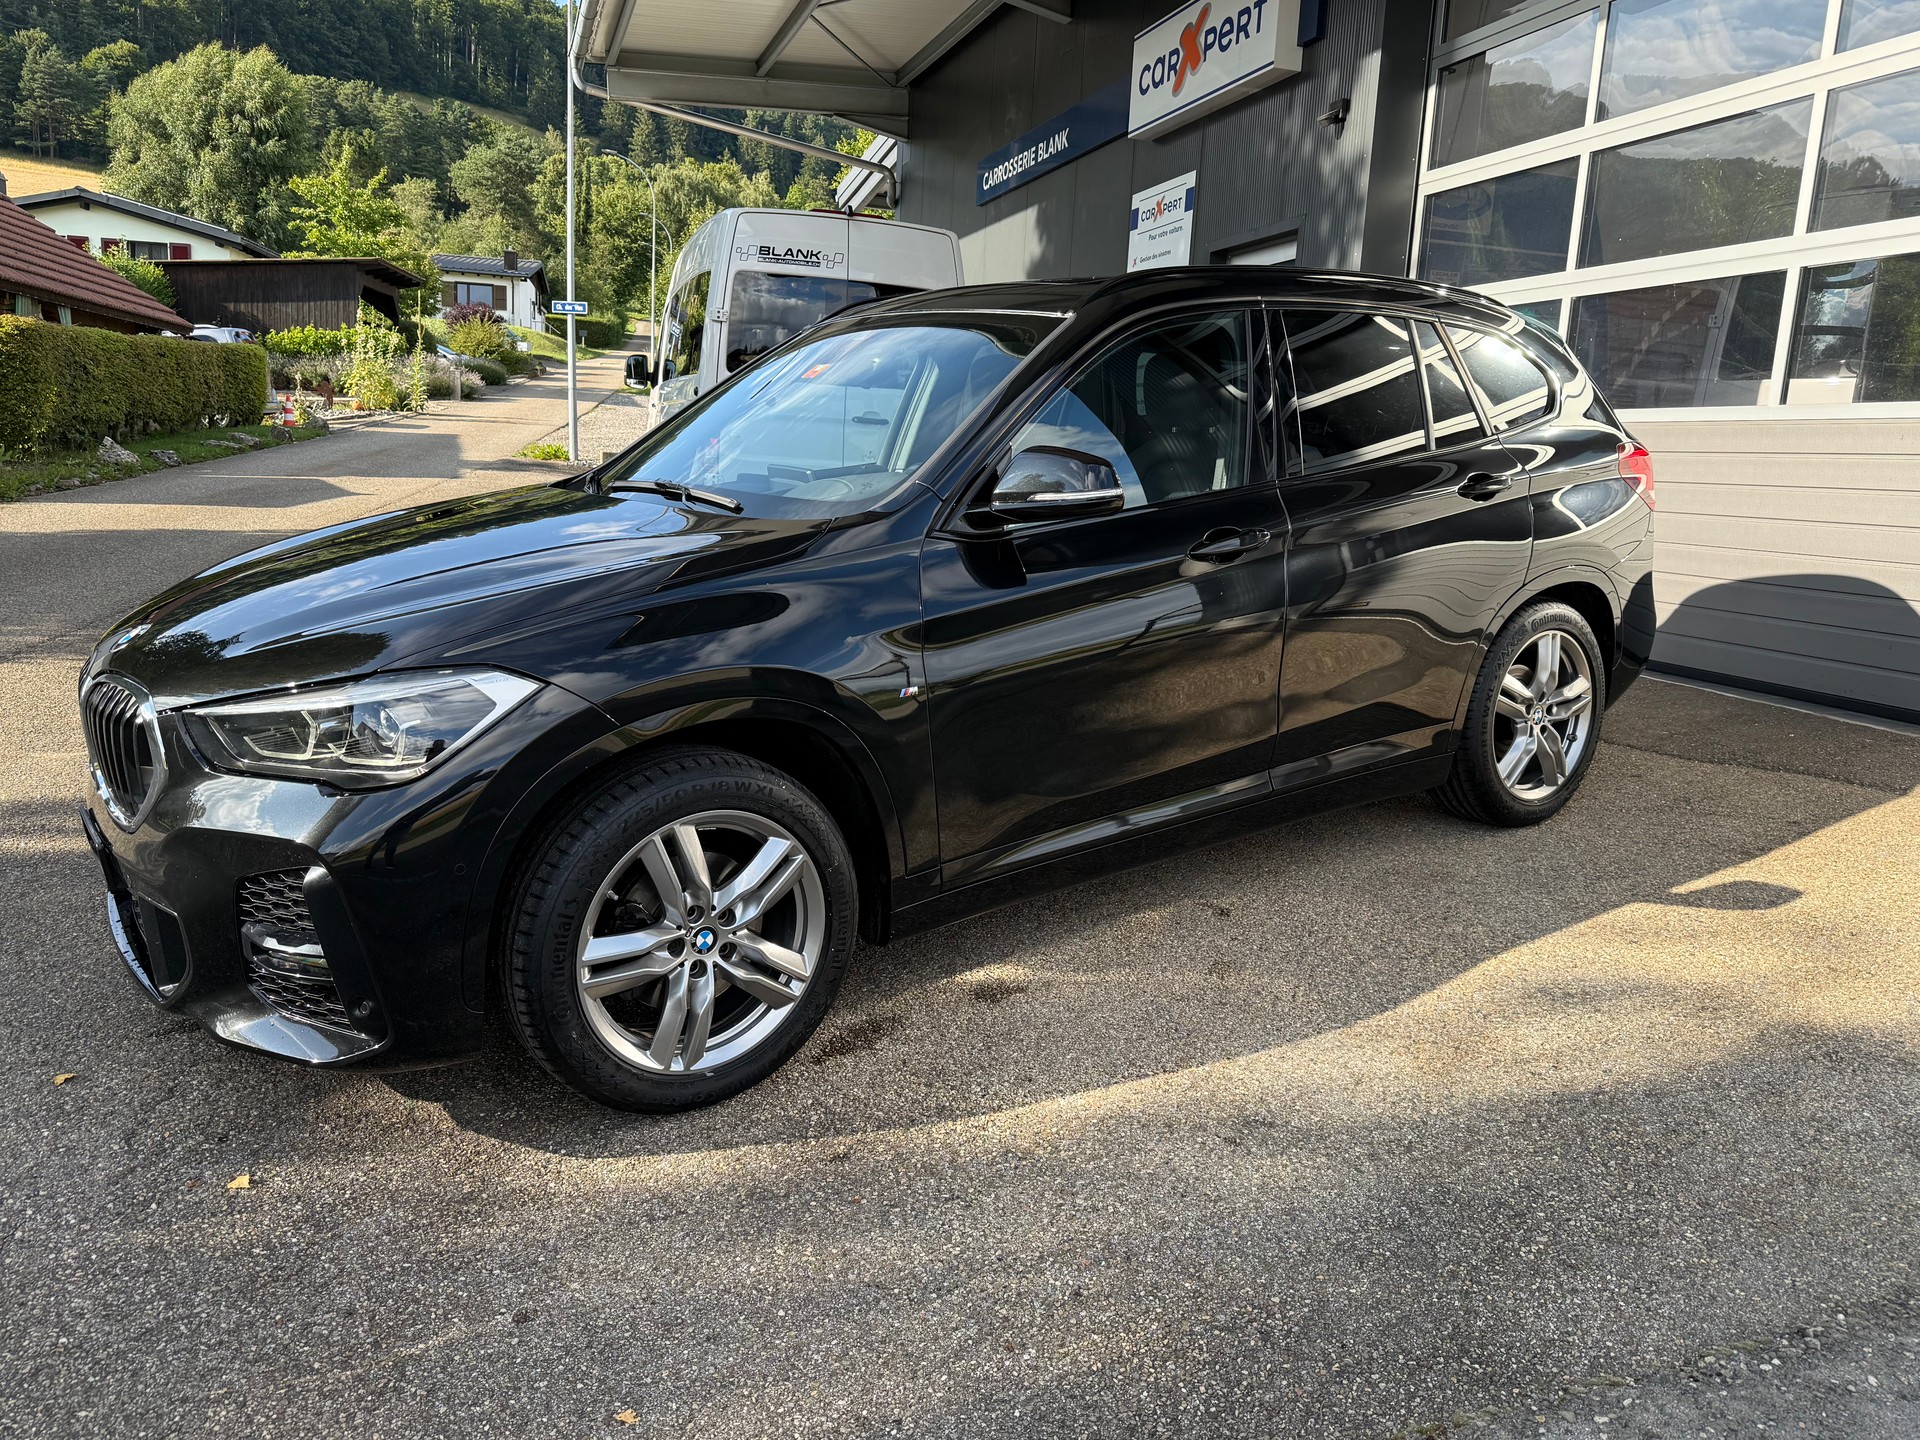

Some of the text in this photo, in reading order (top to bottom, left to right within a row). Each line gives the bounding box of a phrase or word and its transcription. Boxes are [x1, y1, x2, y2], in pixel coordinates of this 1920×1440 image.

[982, 127, 1070, 191] CARROSSERIE BLANK
[1148, 233, 1158, 241] Pour
[1158, 229, 1168, 238] votre
[759, 245, 822, 260] BLANK
[1531, 612, 1573, 632] Continental
